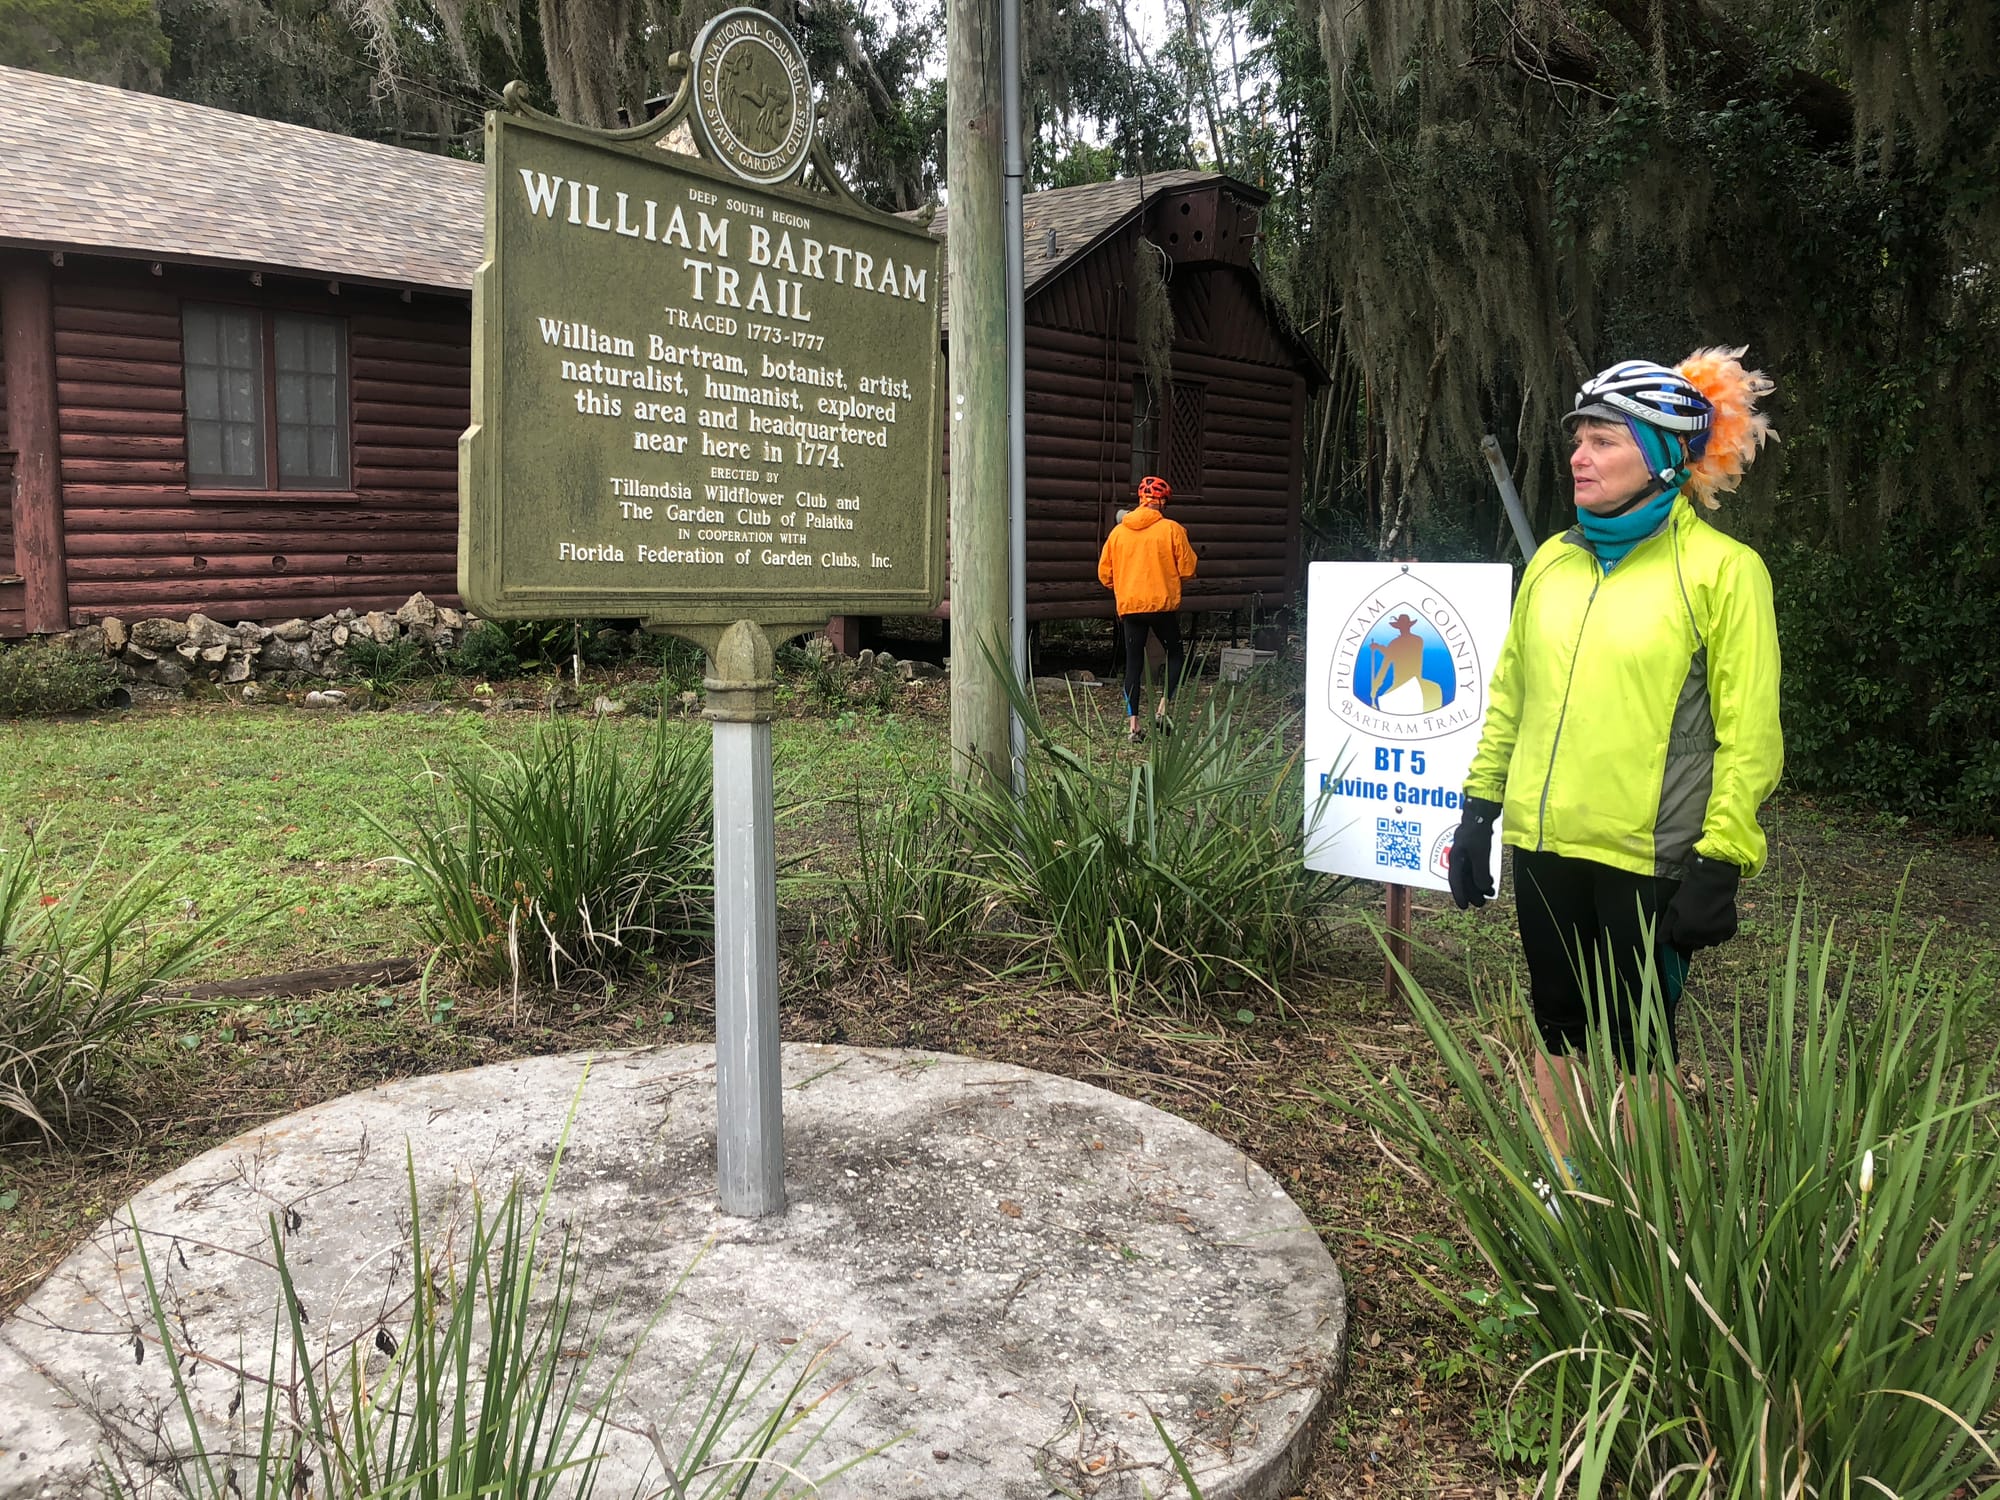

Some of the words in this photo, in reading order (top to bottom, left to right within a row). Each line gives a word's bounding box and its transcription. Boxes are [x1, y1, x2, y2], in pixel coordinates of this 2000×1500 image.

[704, 20, 761, 69] NATIONAL
[765, 29, 804, 95] COUNCIL
[703, 79, 715, 102] OF
[707, 108, 737, 155] STATE
[786, 110, 806, 155] CLUBS
[738, 152, 787, 172] GARDEN
[688, 188, 718, 206] DEEP
[726, 198, 764, 218] SOUTH
[772, 210, 810, 230] REGION
[519, 168, 730, 258] WILLIAM
[749, 225, 928, 303] BARTRAM
[683, 257, 813, 322] TRAIL
[664, 306, 738, 336] TRACED
[747, 322, 825, 352] 1773-1777
[536, 317, 635, 358] William
[648, 334, 749, 377] Bartram,
[761, 354, 848, 391] botanist,
[859, 375, 912, 401] artist,
[561, 359, 689, 397] naturalist,
[704, 374, 804, 412] humanist,
[817, 396, 896, 423] explored
[574, 388, 622, 417] this
[634, 400, 687, 424] area
[698, 406, 738, 430] and
[749, 409, 888, 447] headquartered
[633, 431, 688, 453] near
[701, 432, 751, 460] here
[763, 441, 783, 463] in
[796, 442, 845, 468] 1774.
[610, 477, 692, 500] Tillandsia
[704, 484, 785, 506] Wildflower
[796, 491, 828, 509] Club
[836, 496, 860, 511] and
[711, 466, 760, 482] ERECTED
[766, 472, 779, 483] BY
[620, 501, 653, 520] The
[667, 504, 725, 524] Garden
[737, 508, 771, 526] Club
[781, 511, 796, 527] of
[805, 512, 854, 530] Palatka
[559, 542, 624, 562] Florida
[638, 544, 724, 564] Federation
[735, 549, 751, 565] of
[761, 549, 812, 566] Garden
[821, 552, 860, 569] Clubs,
[871, 552, 893, 568] Inc.
[678, 528, 691, 540] IN
[697, 529, 773, 543] COOPERATION
[779, 533, 807, 544] WITH
[1336, 598, 1386, 689] PUTNAM
[1421, 597, 1475, 693] COUNTY
[1341, 700, 1419, 734] BARTRAM
[1423, 708, 1473, 732] TRAIL
[1374, 746, 1405, 773] BT
[1410, 750, 1426, 775] 5
[1320, 773, 1388, 801] Ravine
